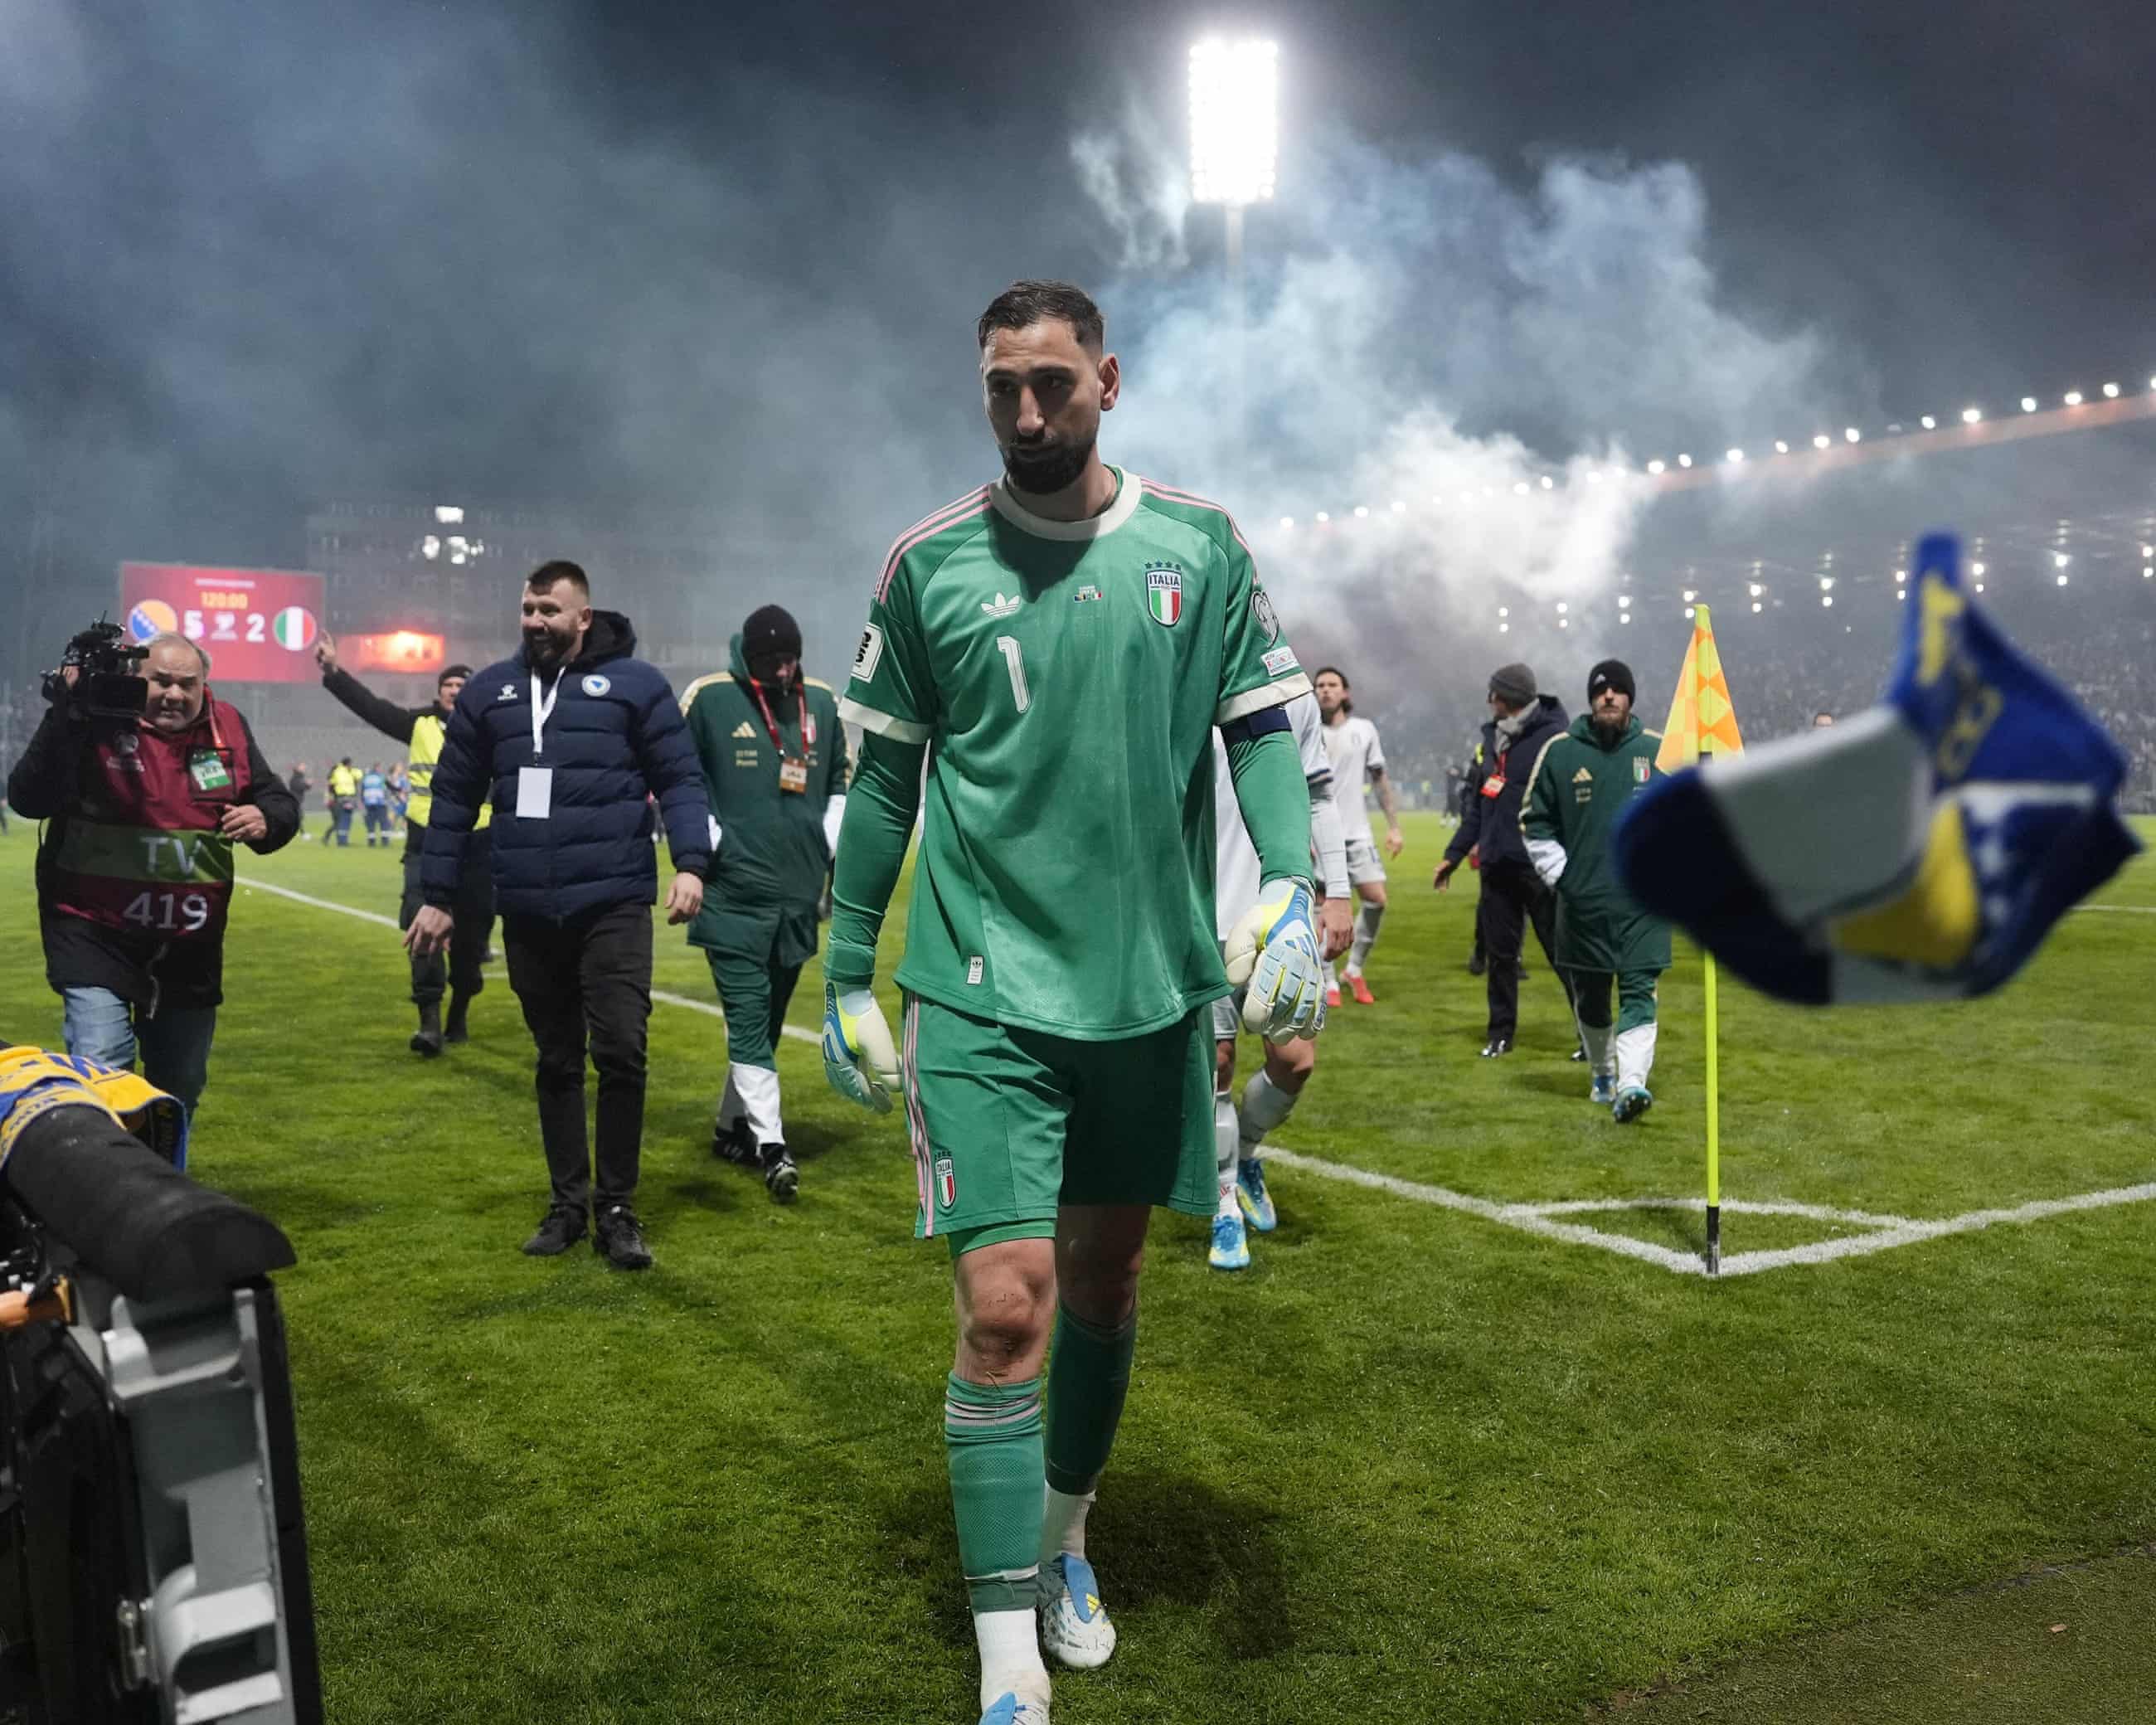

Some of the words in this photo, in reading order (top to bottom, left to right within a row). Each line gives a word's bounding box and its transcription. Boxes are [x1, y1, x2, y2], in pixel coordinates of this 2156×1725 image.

[1148, 574, 1180, 586] ITALIA
[184, 610, 204, 639] 5
[245, 613, 265, 642] 2
[997, 635, 1031, 713] 1
[139, 835, 202, 875] TV
[123, 891, 208, 931] 419
